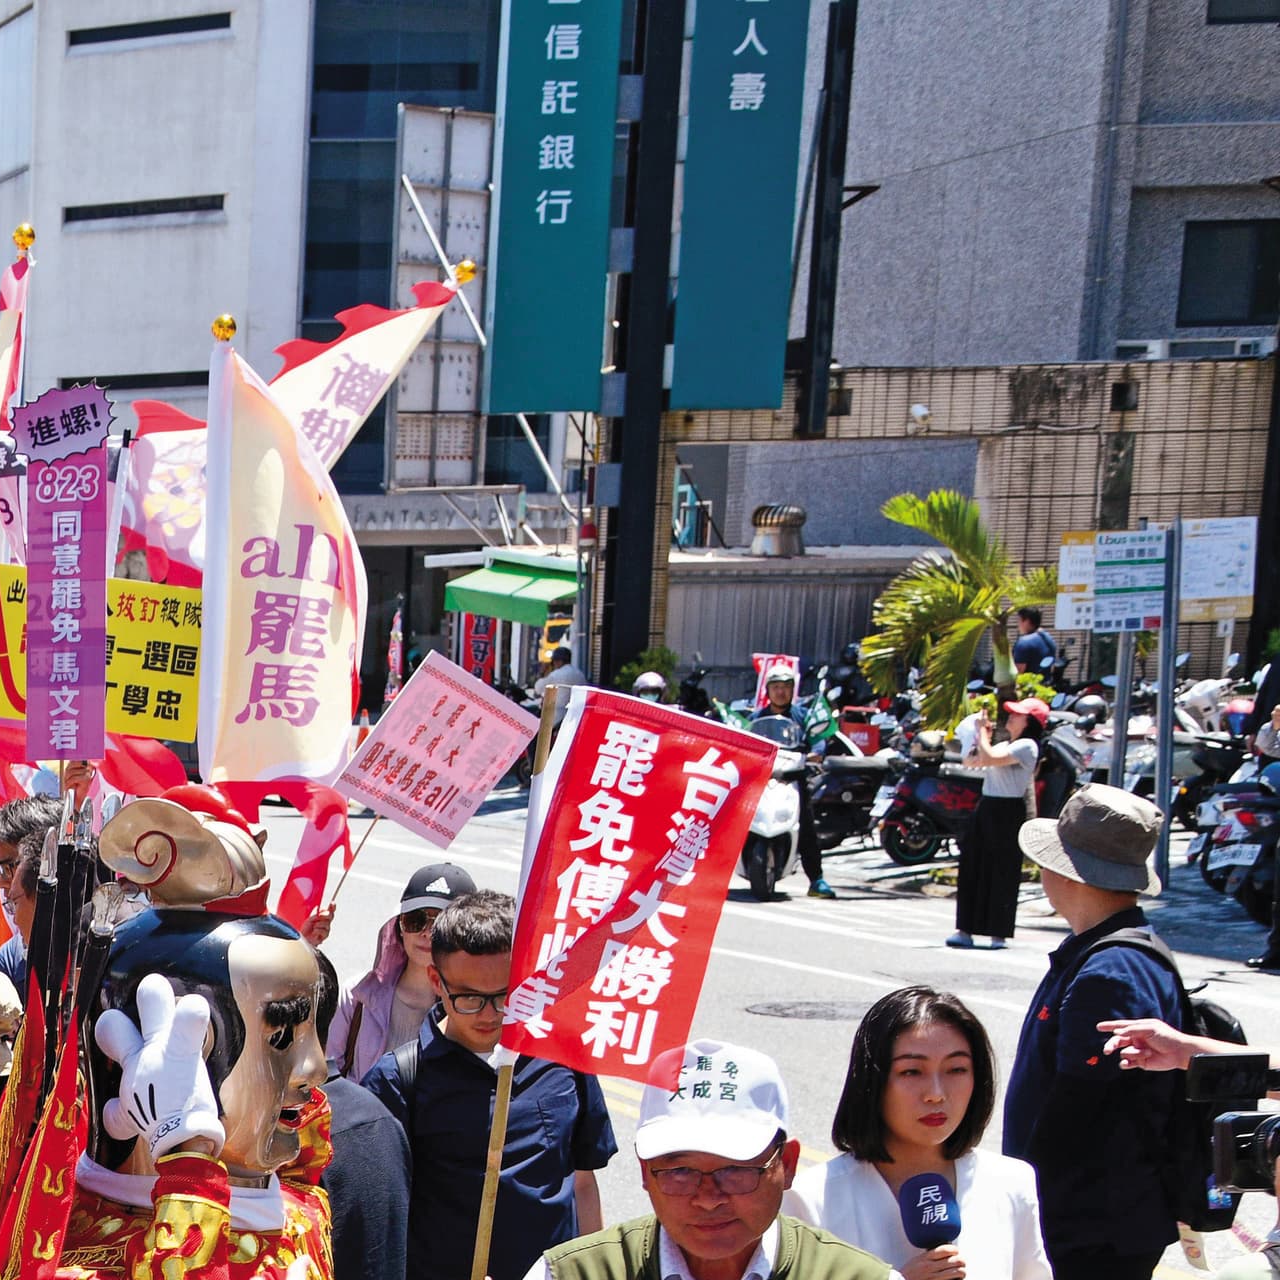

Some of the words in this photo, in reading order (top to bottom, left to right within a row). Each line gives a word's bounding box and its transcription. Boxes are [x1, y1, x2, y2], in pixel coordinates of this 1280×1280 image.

[728, 0, 769, 111] 人壽
[535, 0, 583, 224] 信託銀行
[35, 464, 100, 503] 823
[354, 503, 458, 524] FANTASY
[6, 578, 203, 629] 出拔釘總隊
[50, 510, 83, 643] 同意罷免
[48, 652, 82, 752] 馬文君
[235, 590, 330, 727] 罷馬
[580, 747, 741, 1065] 台灣大勝利
[669, 1080, 739, 1103] 大成宮
[918, 1184, 948, 1226] 民視
